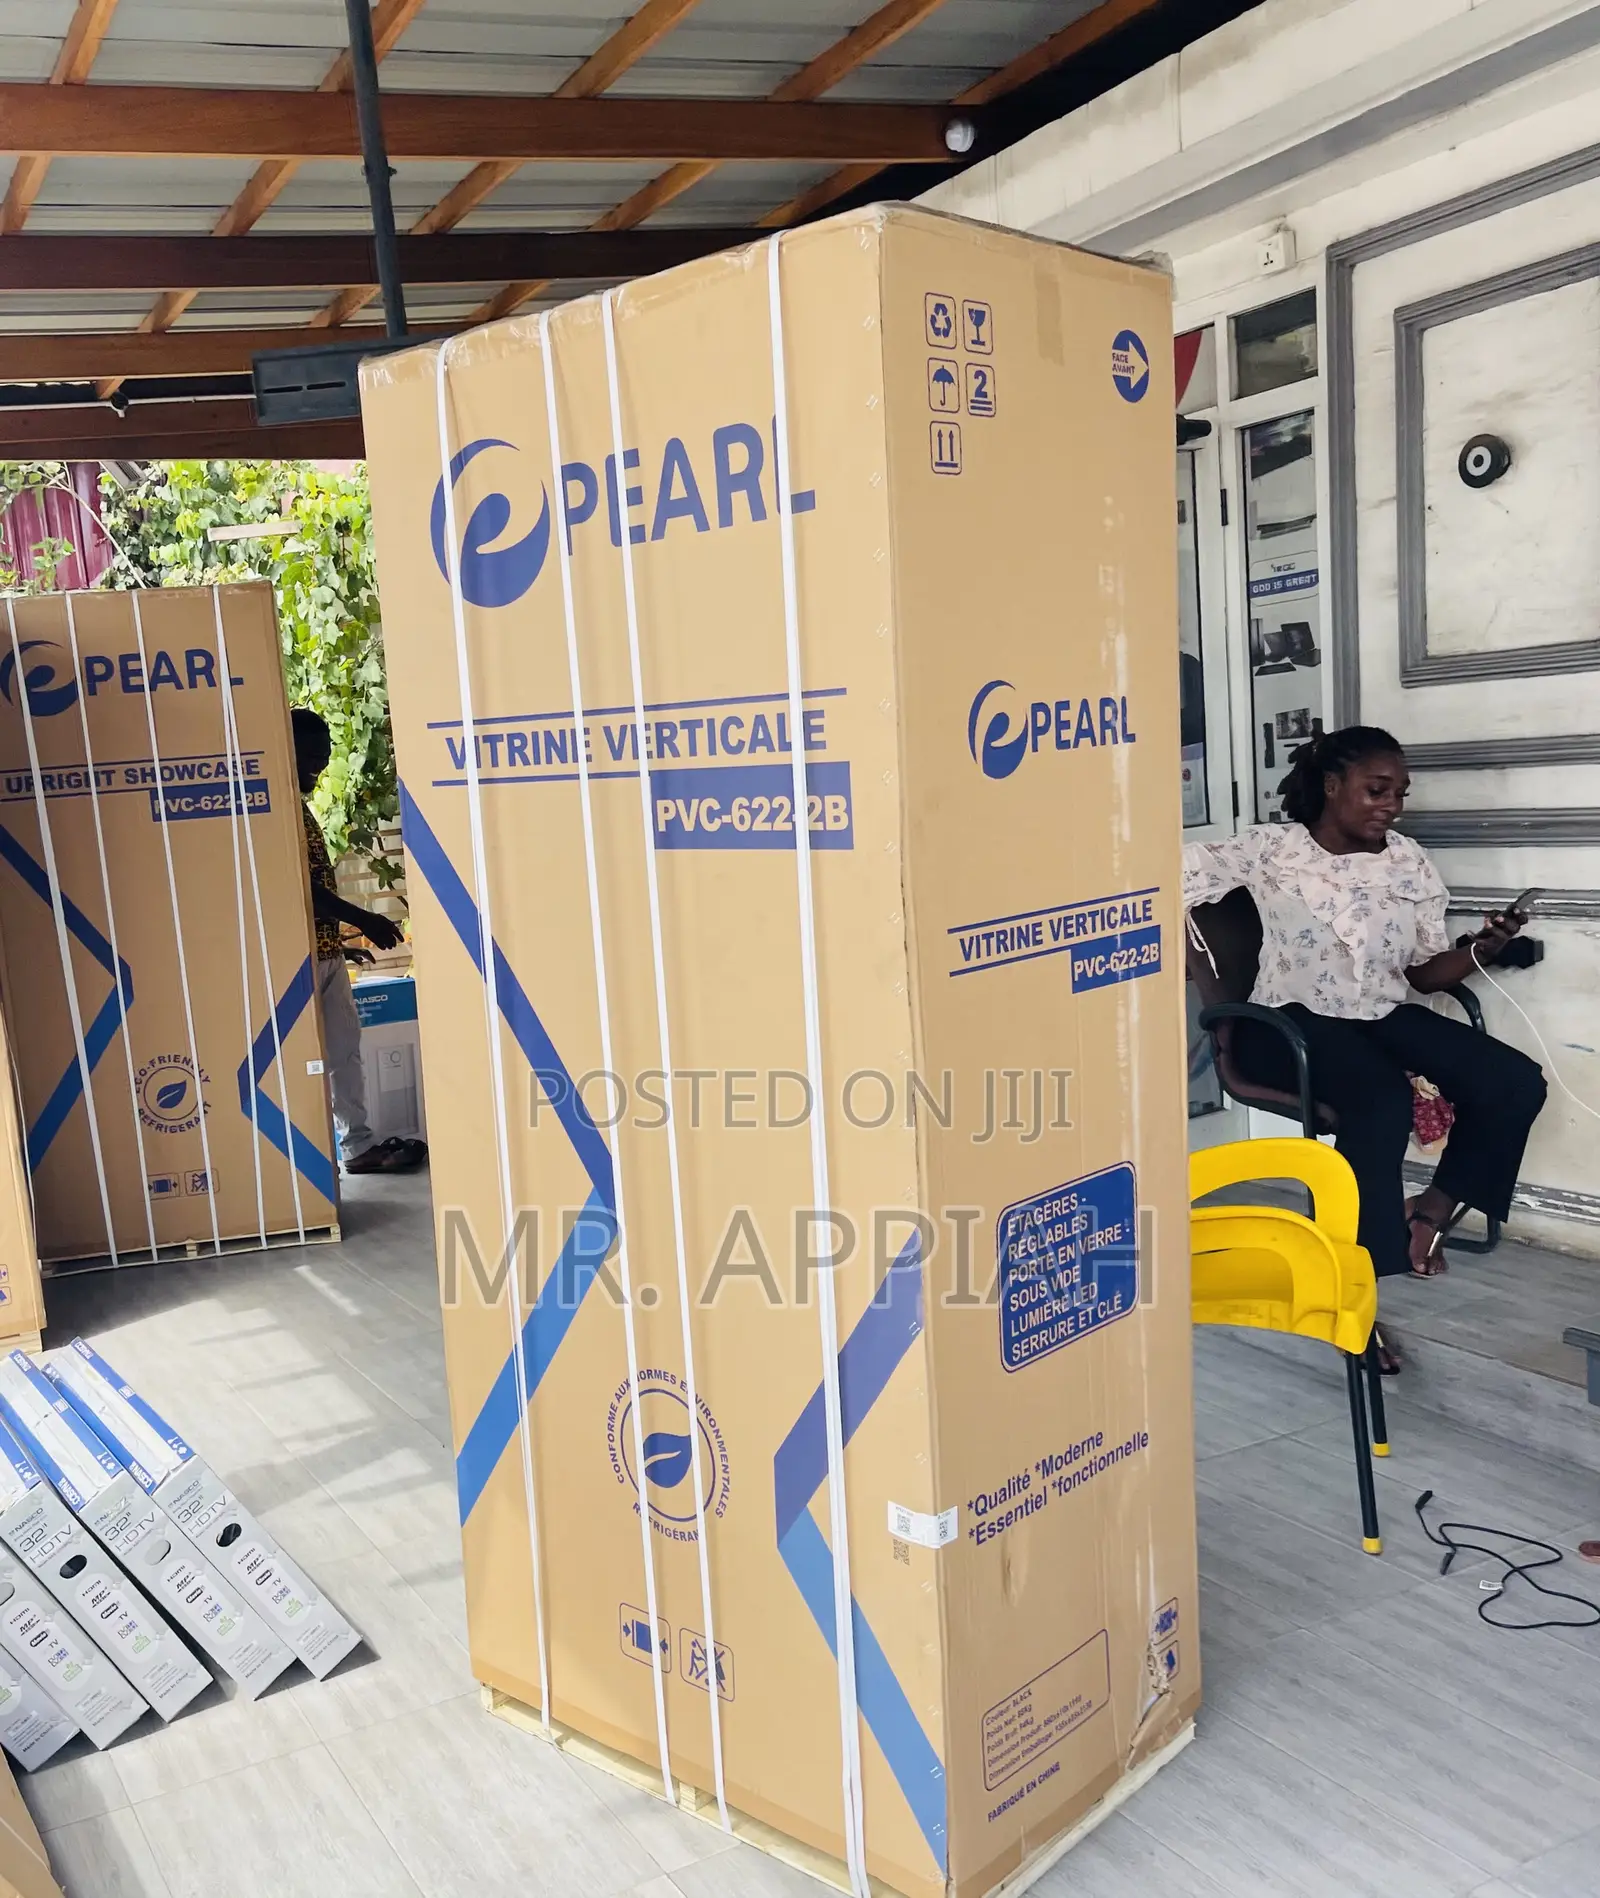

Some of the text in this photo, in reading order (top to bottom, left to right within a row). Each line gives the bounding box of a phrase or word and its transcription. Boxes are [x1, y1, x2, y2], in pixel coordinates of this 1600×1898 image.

[1112, 352, 1129, 363] FACE
[1112, 363, 1135, 376] AVANT
[560, 414, 816, 556] PEARL
[1252, 583, 1271, 593] GOD
[1286, 574, 1317, 588] GREAT
[446, 709, 827, 770] VITRINE VERTICALE
[1031, 696, 1136, 753] PEARL
[5, 758, 260, 794] UPRIGHT SHOWCASE
[656, 794, 850, 833] PVC-622-2B
[959, 898, 1153, 962] VITRINE VERTICALE
[1073, 942, 1159, 982] PVC-622-2B
[135, 1054, 211, 1094] ECO-FRIENLY
[138, 1101, 211, 1134] REFRIGERAT
[1007, 1192, 1078, 1237] ÉTAGÈRES
[1008, 1213, 1088, 1263] RÉGLABLES
[1009, 1251, 1054, 1287] PORTE
[1059, 1242, 1075, 1265] EN
[1079, 1223, 1122, 1256] VERRE
[1010, 1265, 1081, 1312] SOUS VIDE
[1011, 1282, 1098, 1337] LUMIÈRE LED
[1012, 1289, 1123, 1362] SERRURE ET CLÉ
[615, 1378, 632, 1403] AUX
[607, 1402, 625, 1484] CONFORME
[679, 1380, 731, 1518] EVIRONMENTALES
[14, 1507, 43, 1532] NASCO
[104, 1511, 131, 1541] 32"
[177, 1495, 204, 1524] 32"
[187, 1495, 226, 1534] HDTV
[632, 1502, 700, 1542] RFRIGÉRAN
[19, 1522, 48, 1552] 32"
[29, 1523, 72, 1564] HDTV
[115, 1511, 155, 1552] HDTV
[204, 1595, 213, 1605] TV
[272, 1577, 282, 1587] TV
[119, 1610, 128, 1620] TV
[48, 1638, 59, 1648] TV
[1026, 1779, 1037, 1794] EN
[1038, 1761, 1060, 1784] CHINE
